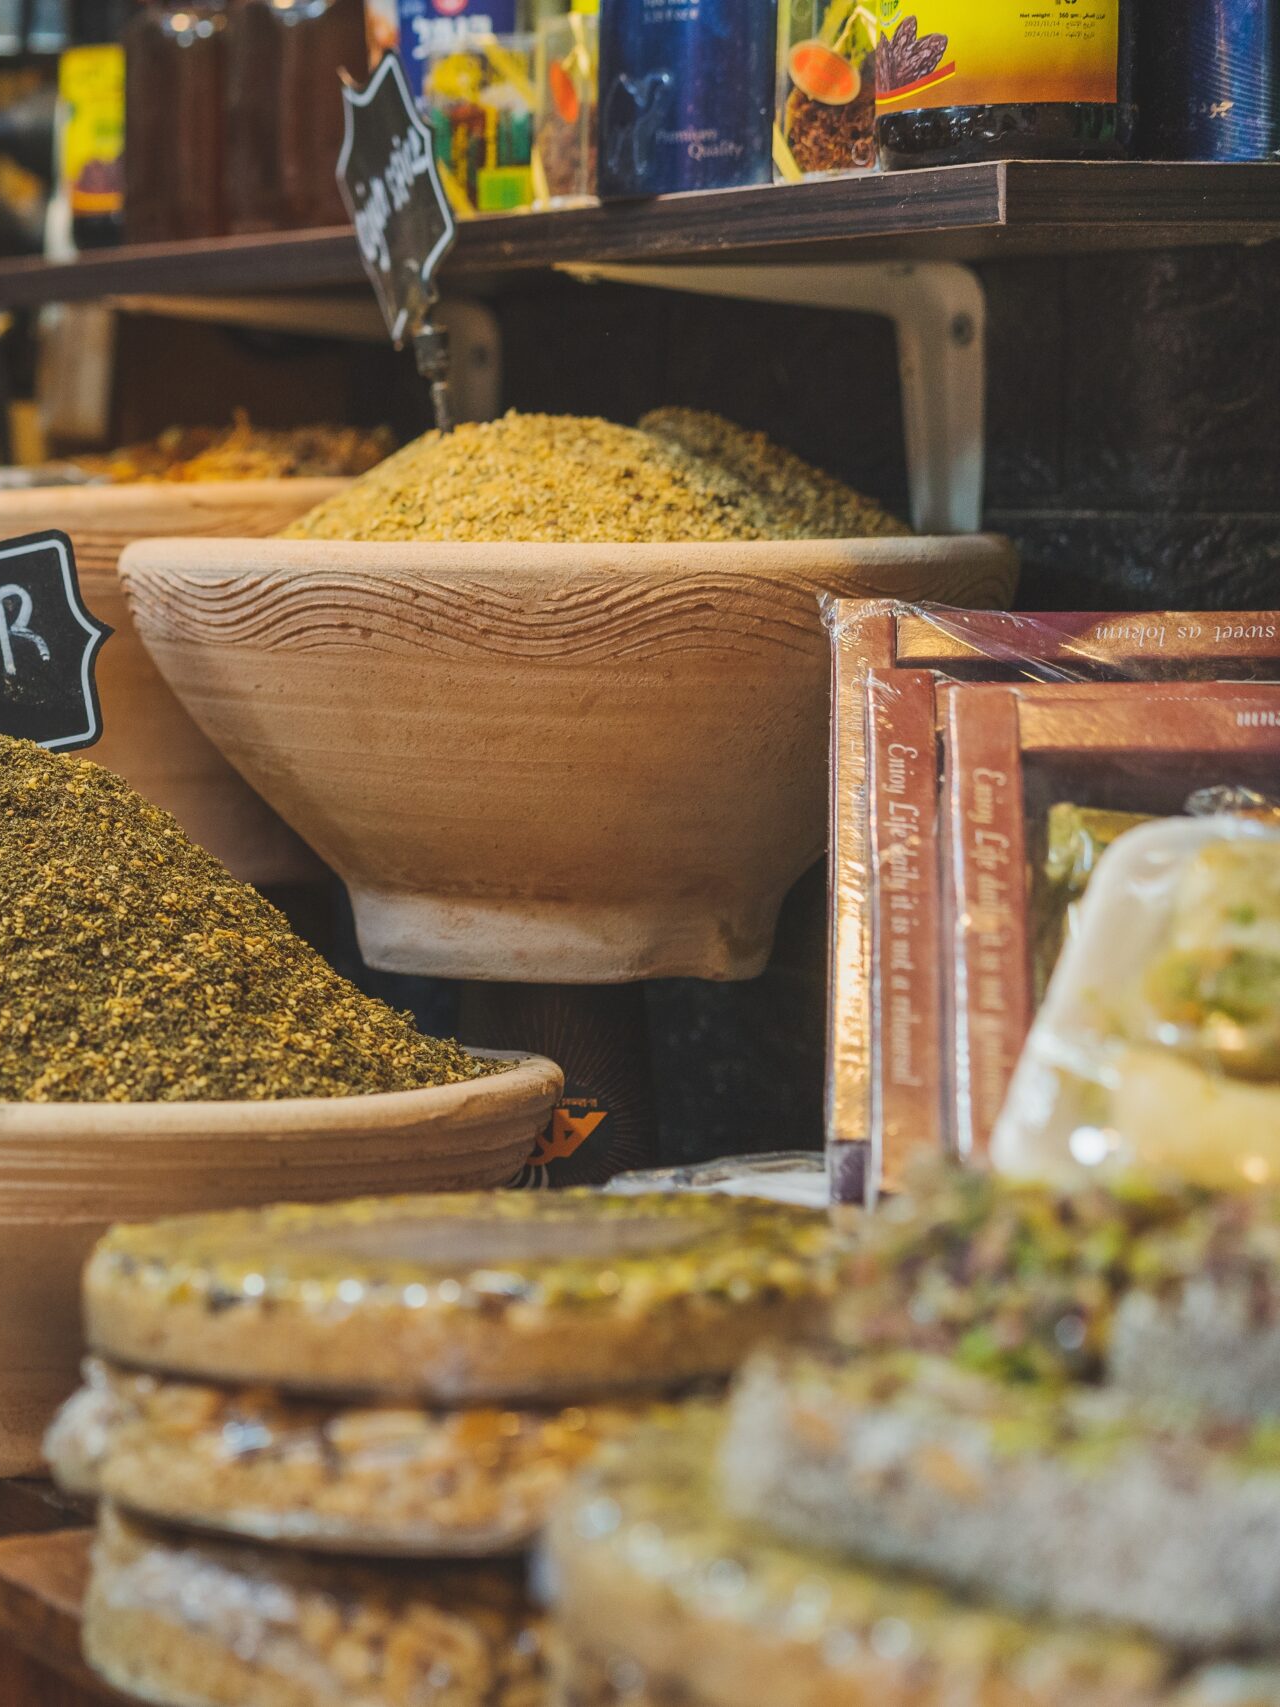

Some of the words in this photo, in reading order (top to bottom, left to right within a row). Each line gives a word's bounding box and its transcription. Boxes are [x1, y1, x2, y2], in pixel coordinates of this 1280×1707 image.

[1095, 624, 1166, 647] lokum
[1177, 625, 1201, 640] as
[1214, 625, 1276, 642] sweet
[882, 800, 920, 838] Life
[890, 895, 919, 910] it
[890, 916, 919, 934] is
